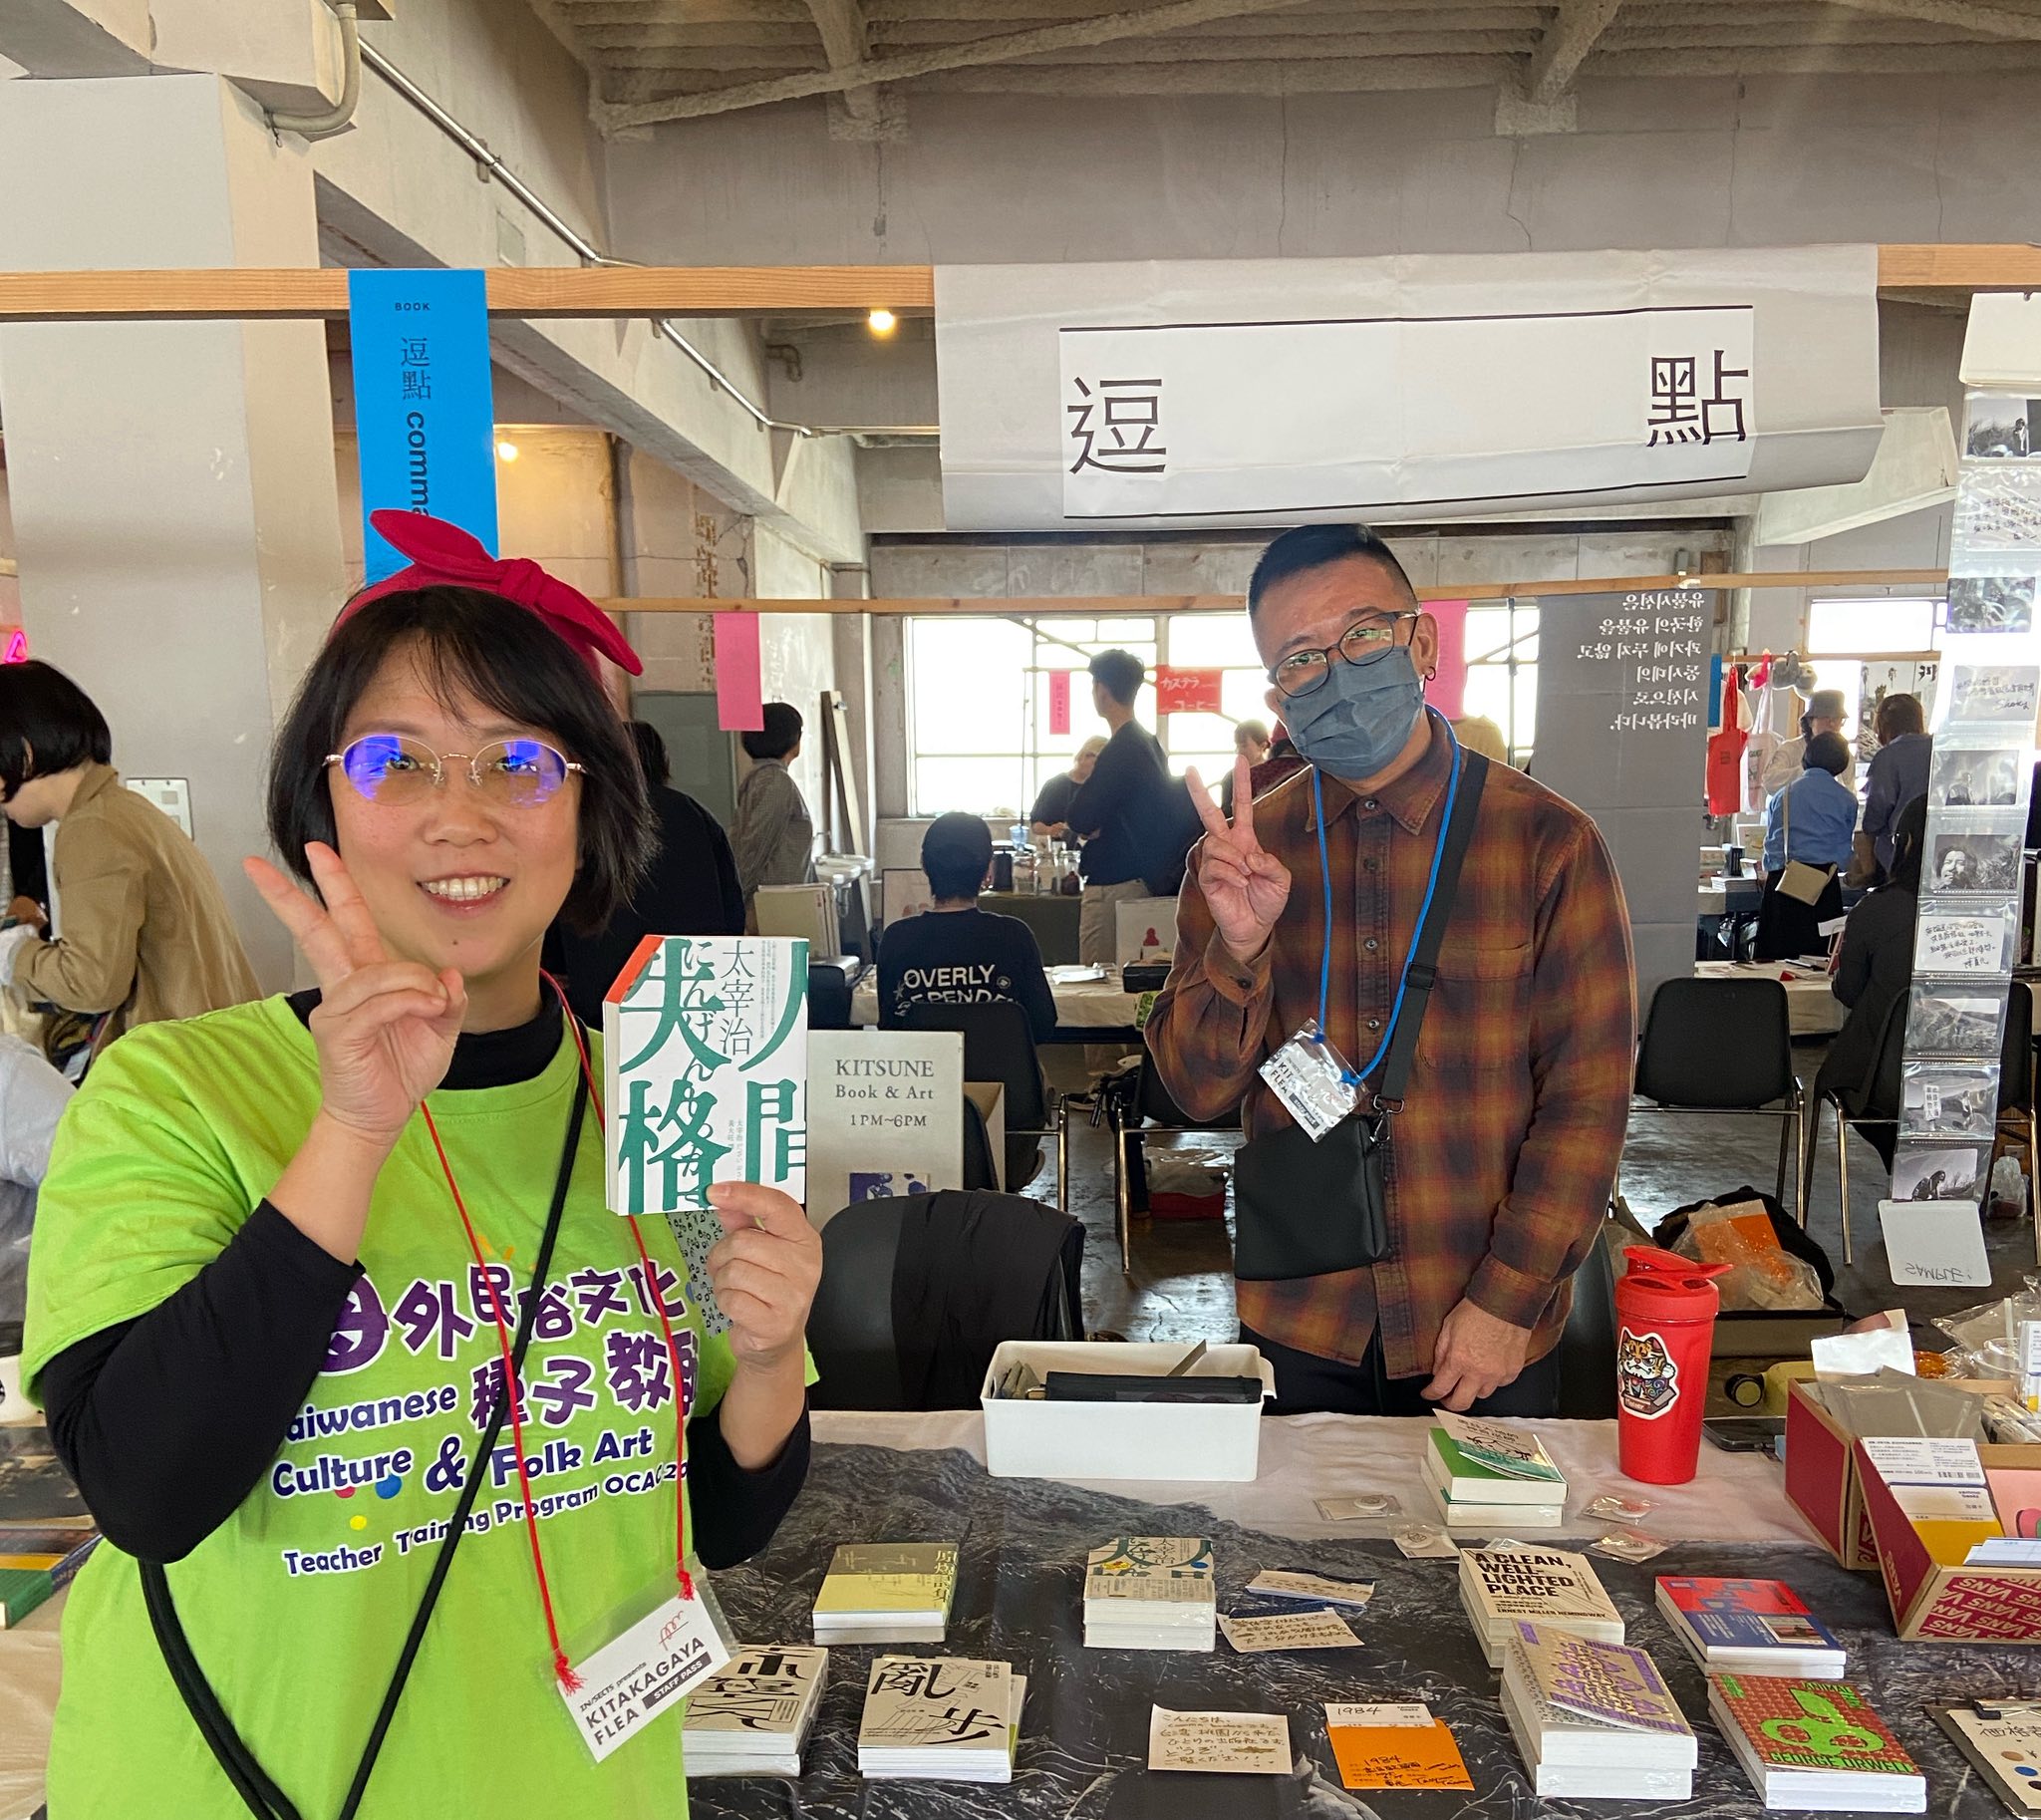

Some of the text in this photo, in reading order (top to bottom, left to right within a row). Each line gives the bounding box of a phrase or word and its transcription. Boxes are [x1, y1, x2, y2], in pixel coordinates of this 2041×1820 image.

[395, 302, 431, 311] BOOK
[401, 337, 432, 400] 逗點
[1066, 349, 1749, 474] 逗 點
[1161, 677, 1200, 691] カステラ
[1174, 700, 1218, 711] コーヒー
[904, 964, 996, 990] OVERLY
[720, 940, 755, 1057] 太宰治
[834, 1059, 935, 1077] KITSUNE
[835, 1084, 934, 1099] Book & Art
[287, 1385, 457, 1442] aiwanese
[272, 1426, 654, 1498] Culture & Folk Art
[283, 1543, 384, 1575] Teacher
[396, 1512, 490, 1553] Tainng
[495, 1485, 598, 1524] Program
[1475, 1553, 1572, 1569] A CLEAN,
[1477, 1563, 1545, 1575] WELL-
[1482, 1573, 1575, 1587] LIGHTED
[1953, 1578, 2012, 1601] VANS
[1487, 1584, 1560, 1597] PLACE
[1930, 1604, 1972, 1623] VAN
[1961, 1598, 2020, 1620] VANS
[1923, 1620, 1980, 1639] VANS
[1969, 1616, 2026, 1636] VANS
[586, 1637, 705, 1728] KITAKAGAYA
[616, 1662, 648, 1687] presents
[653, 1661, 703, 1699] STAFF PASS
[1337, 1706, 1381, 1715] 1984
[594, 1707, 640, 1745] FLEA
[1363, 1755, 1401, 1766] 1984
[1770, 1752, 1914, 1773] GEORGE ORWELL
